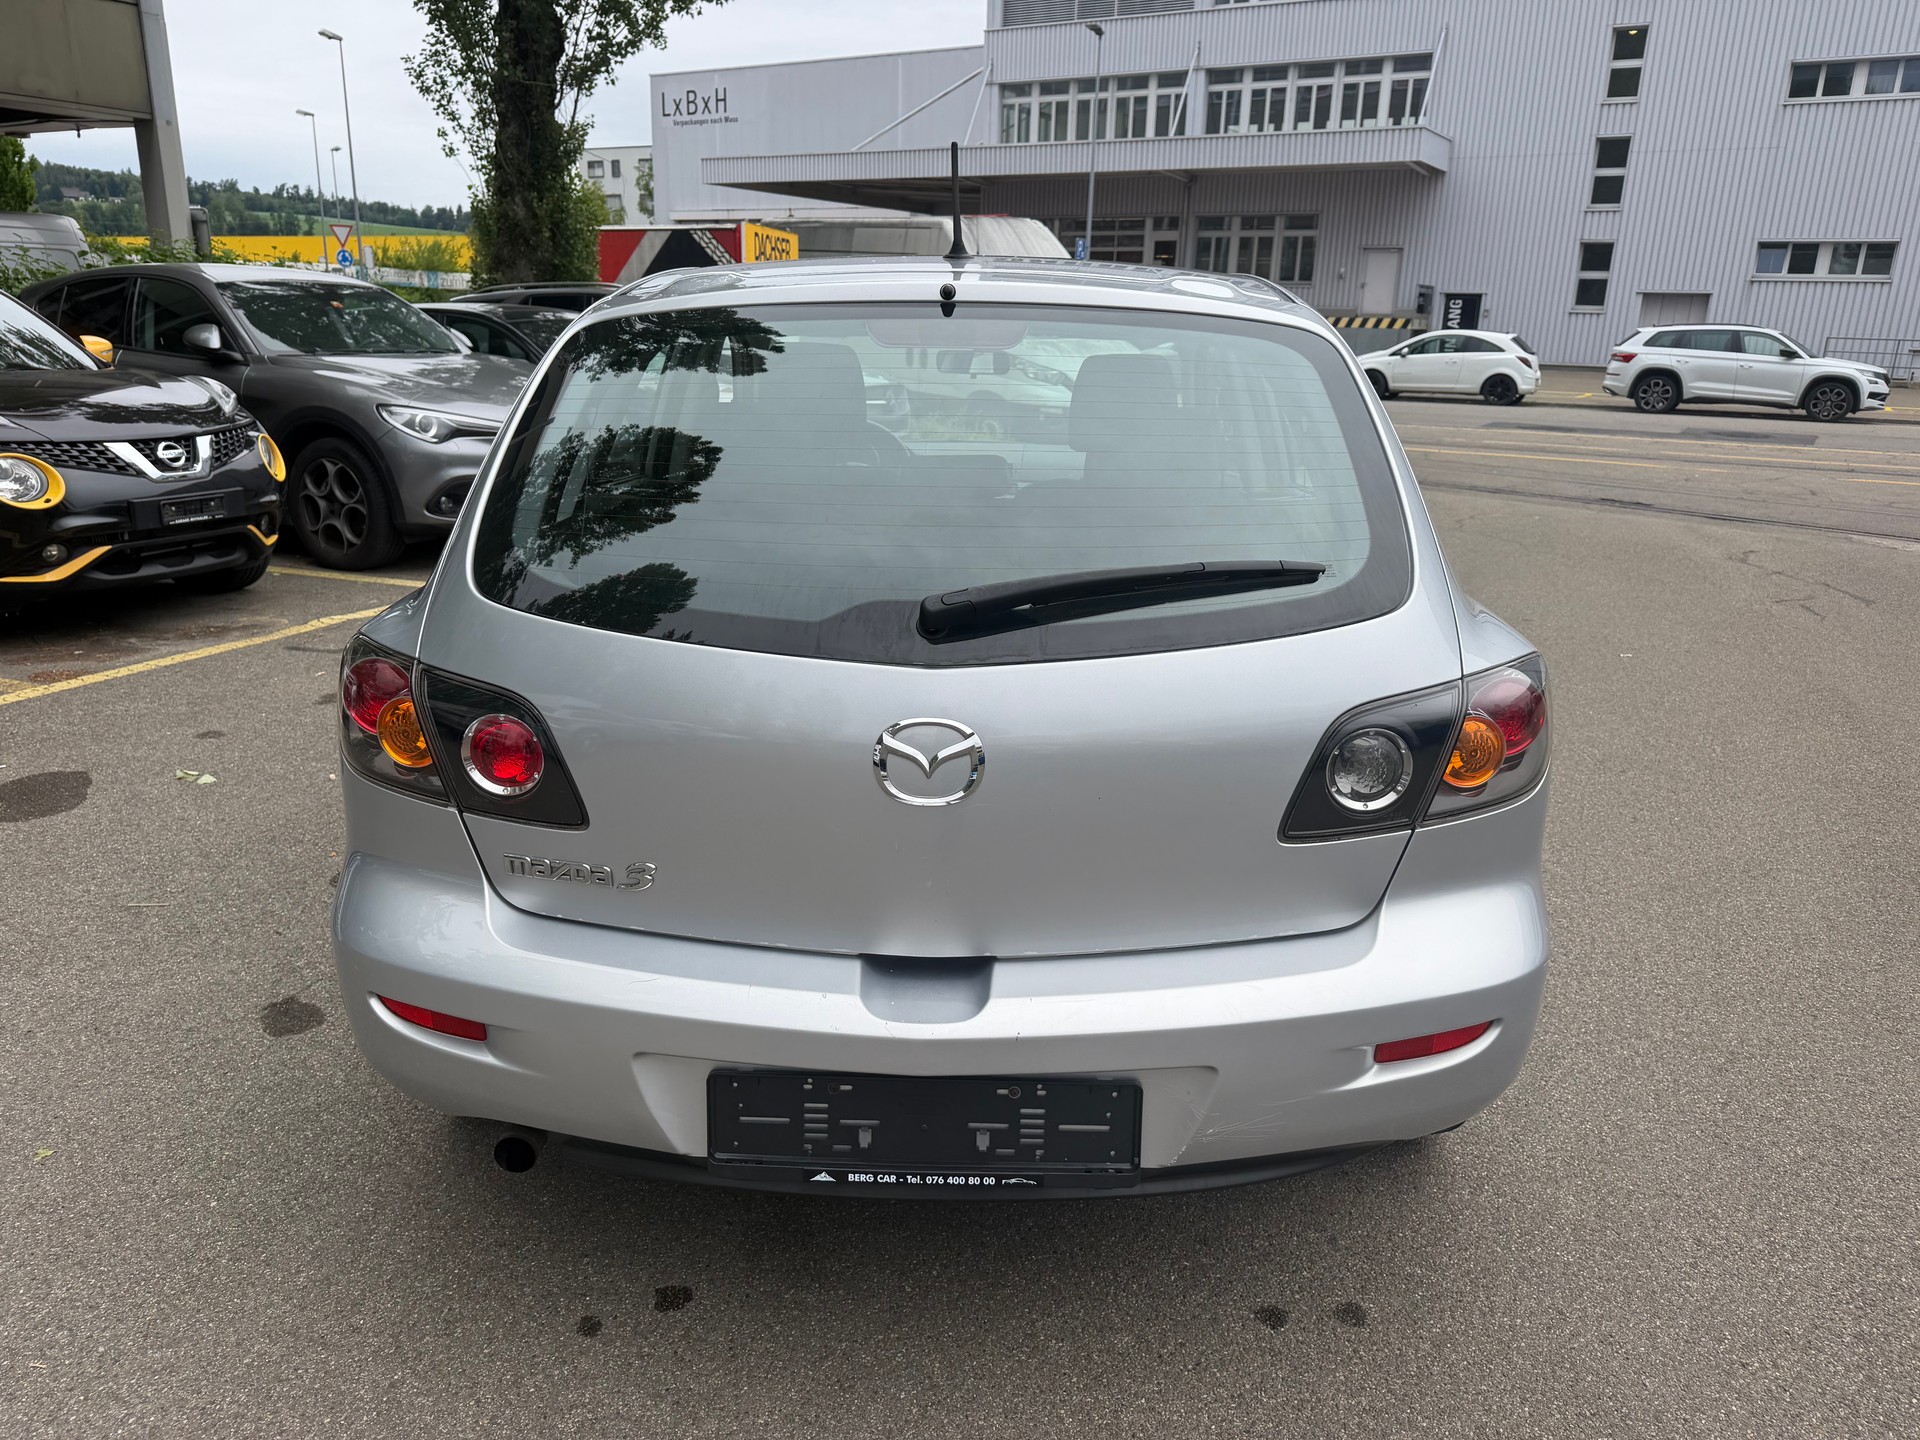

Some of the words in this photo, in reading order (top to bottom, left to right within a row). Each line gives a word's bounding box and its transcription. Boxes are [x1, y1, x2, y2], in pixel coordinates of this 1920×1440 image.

[661, 87, 728, 117] LxBxH
[754, 232, 791, 262] DACHSER
[616, 862, 658, 891] 3
[848, 1173, 874, 1182] BERG
[877, 1174, 896, 1183] CAR
[906, 1175, 923, 1184] Tel.
[926, 1175, 944, 1184] 076
[947, 1176, 965, 1185] 400
[968, 1176, 980, 1185] 80
[983, 1176, 996, 1185] 00
